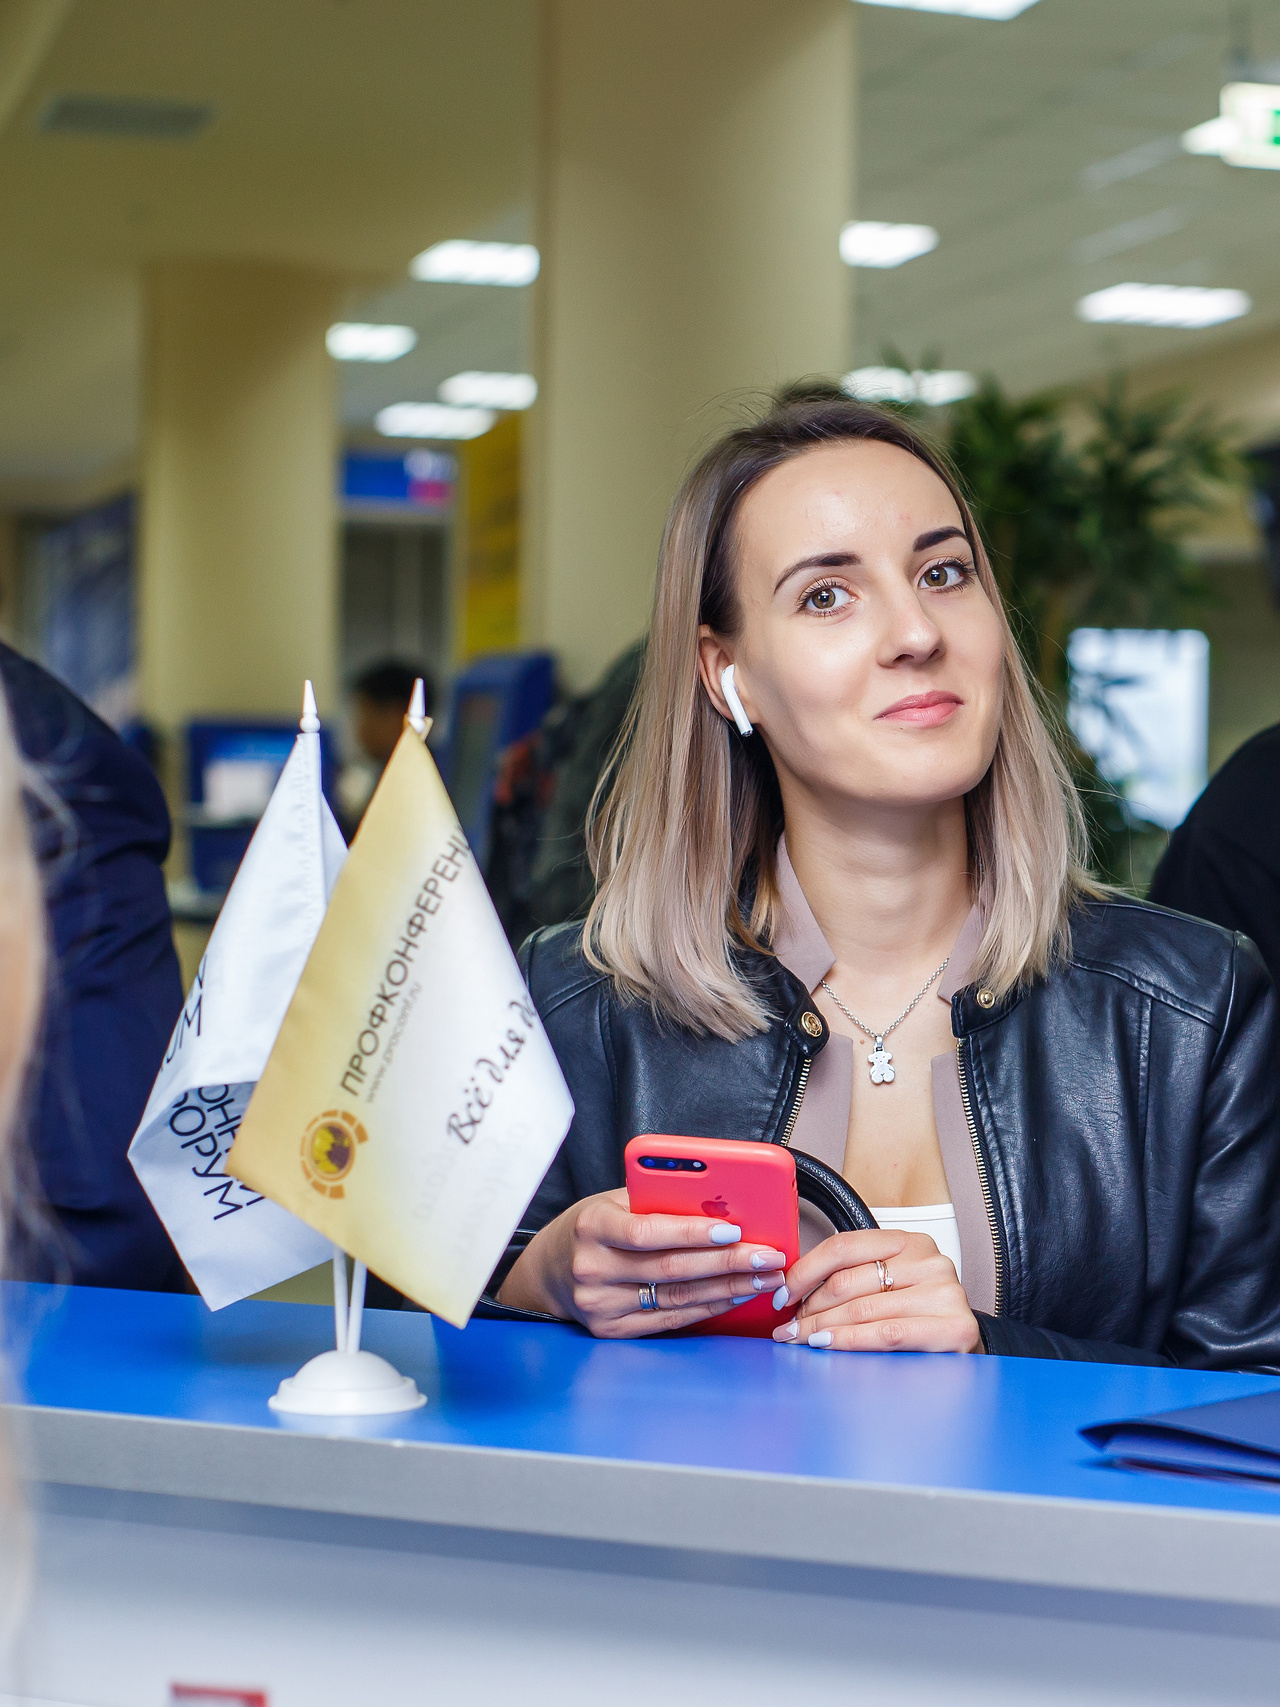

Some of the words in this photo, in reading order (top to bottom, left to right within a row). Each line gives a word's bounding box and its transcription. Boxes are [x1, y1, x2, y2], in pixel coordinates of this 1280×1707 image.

[446, 1076, 494, 1145] Всё
[475, 1028, 527, 1084] для
[169, 1091, 243, 1221] ОРУМ
